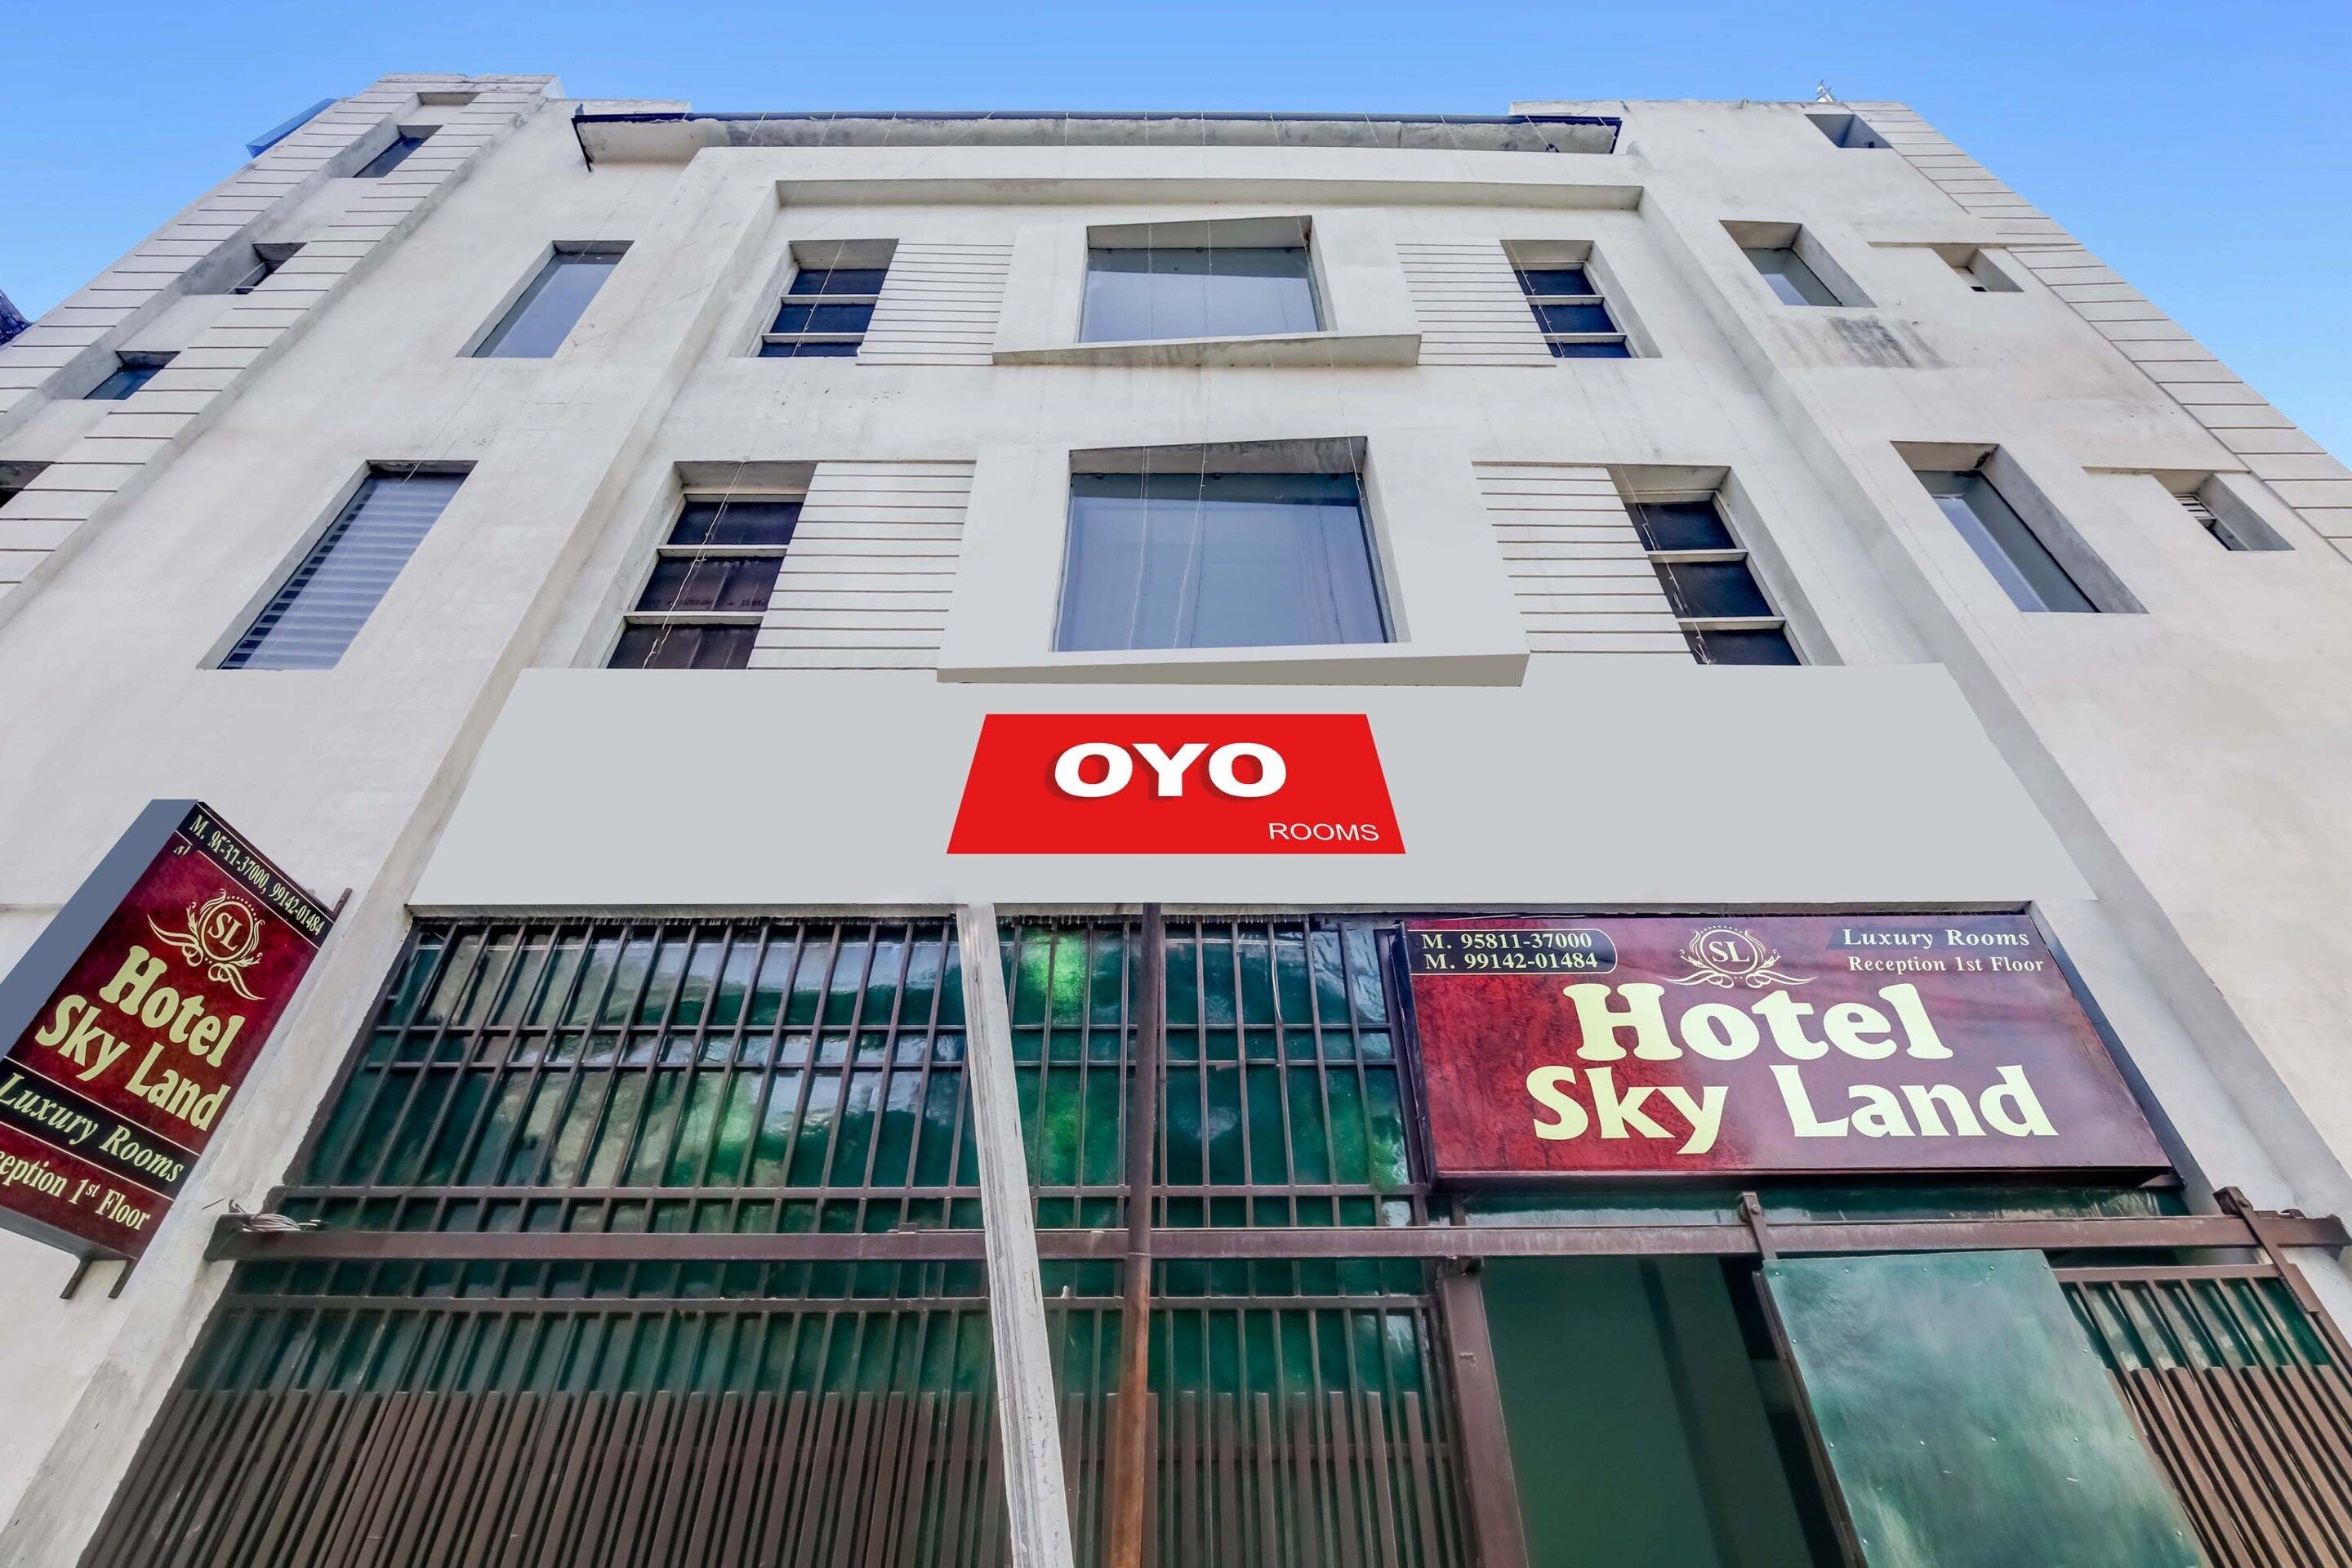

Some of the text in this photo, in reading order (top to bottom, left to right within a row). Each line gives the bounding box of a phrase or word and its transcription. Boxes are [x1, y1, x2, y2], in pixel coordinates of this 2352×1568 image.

[1054, 742, 1287, 797] OYO
[1268, 822, 1379, 841] ROOMS
[189, 814, 205, 840] M.
[269, 883, 325, 935] 99142-01484
[207, 912, 243, 951] SL
[1421, 933, 1592, 950] M. 95811-37000
[1708, 941, 1749, 963] SL
[1842, 929, 2030, 949] Luxury Rooms
[1424, 952, 1598, 969] M. 99142-01484
[1847, 956, 2044, 975] Reception 1st Floor
[100, 945, 245, 1067] Hotel
[1562, 983, 1953, 1061] Hotel
[34, 995, 231, 1131] Sky Land
[0, 1072, 184, 1183] Luxury Rooms
[1526, 1064, 2060, 1154] Sky Land
[69, 1178, 101, 1205] 1st
[95, 1189, 150, 1230] Floor
